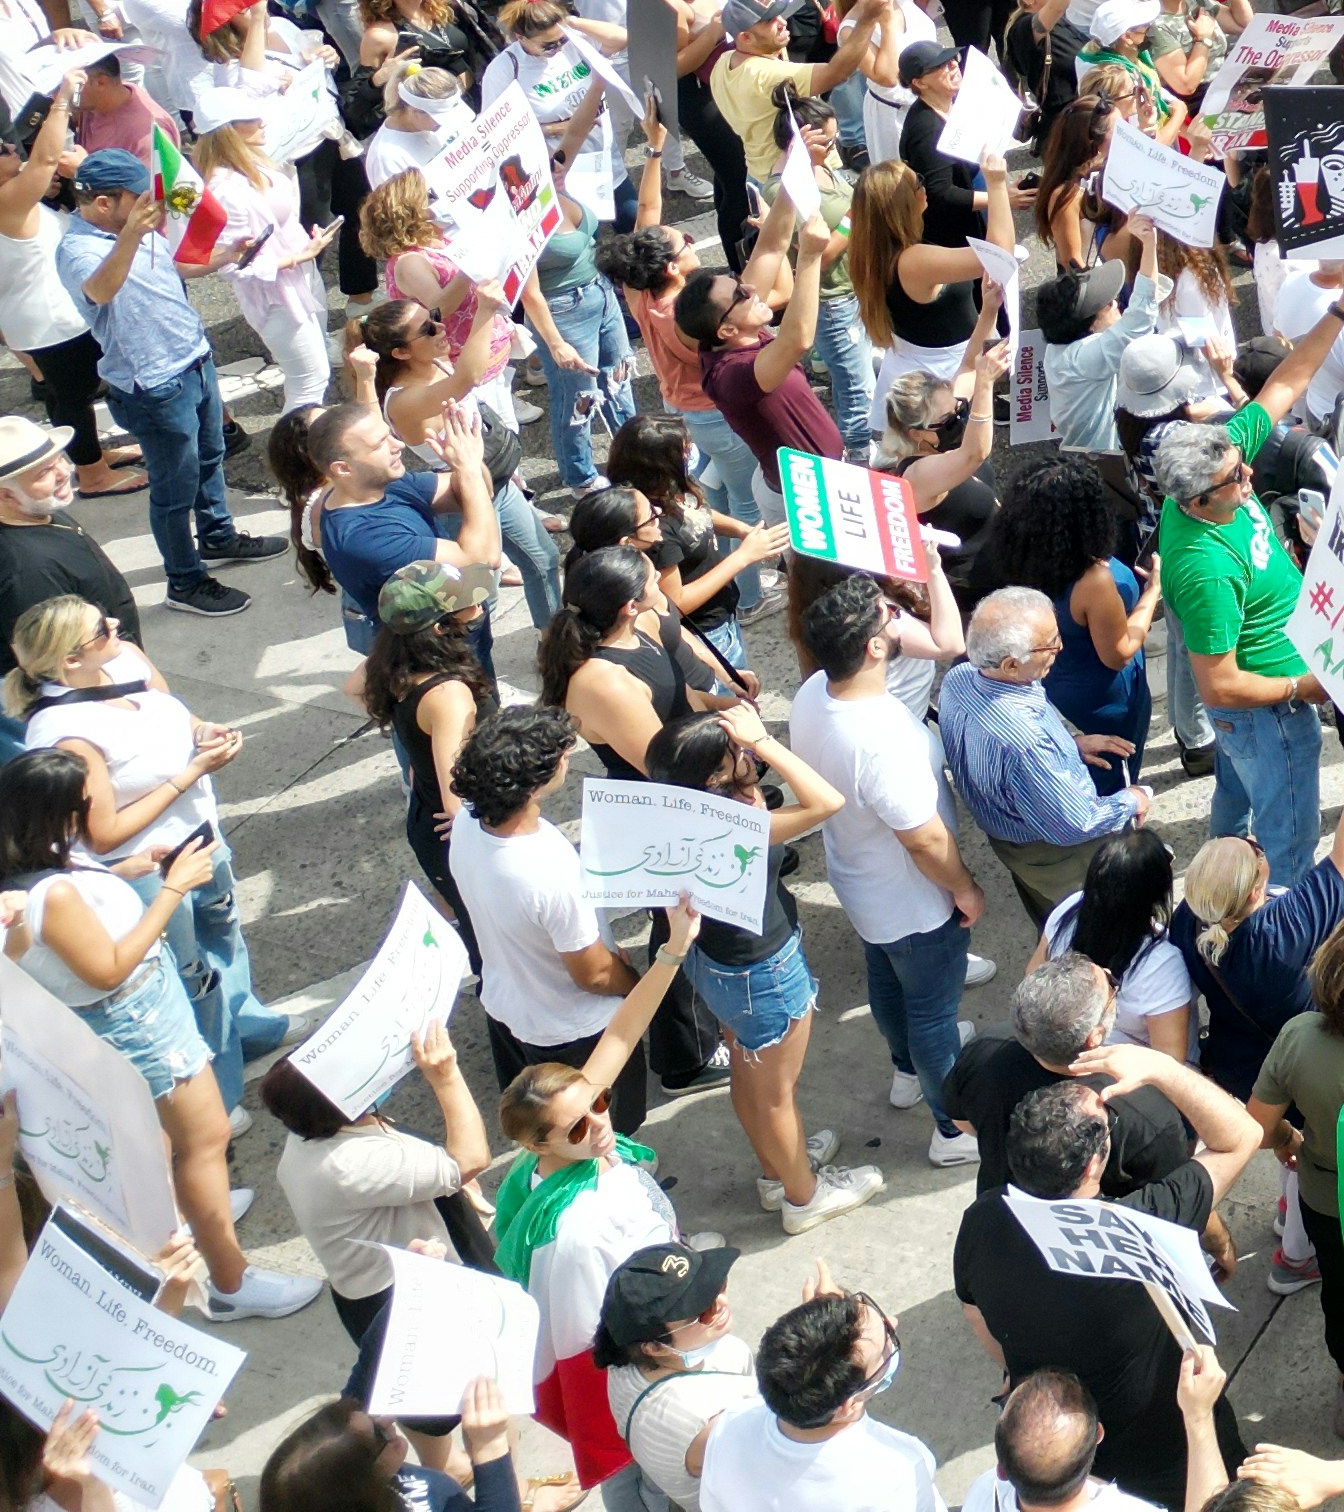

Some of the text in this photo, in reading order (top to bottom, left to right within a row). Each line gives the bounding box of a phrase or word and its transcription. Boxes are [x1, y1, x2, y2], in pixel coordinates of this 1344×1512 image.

[1235, 44, 1329, 73] The Oppressor
[1265, 18, 1301, 37] Media
[444, 101, 513, 171] Media Silence
[445, 110, 532, 205] Supporting Oppressor
[1014, 345, 1032, 423] Media Silence
[792, 453, 823, 552] WOMEN
[837, 489, 864, 540] LIFE
[885, 479, 917, 576] FREEDOM
[1049, 1206, 1160, 1240] SAY
[1057, 1227, 1172, 1272] HER
[39, 1238, 221, 1378] Woman. Life. Freedom.
[1052, 1246, 1209, 1333] NAME
